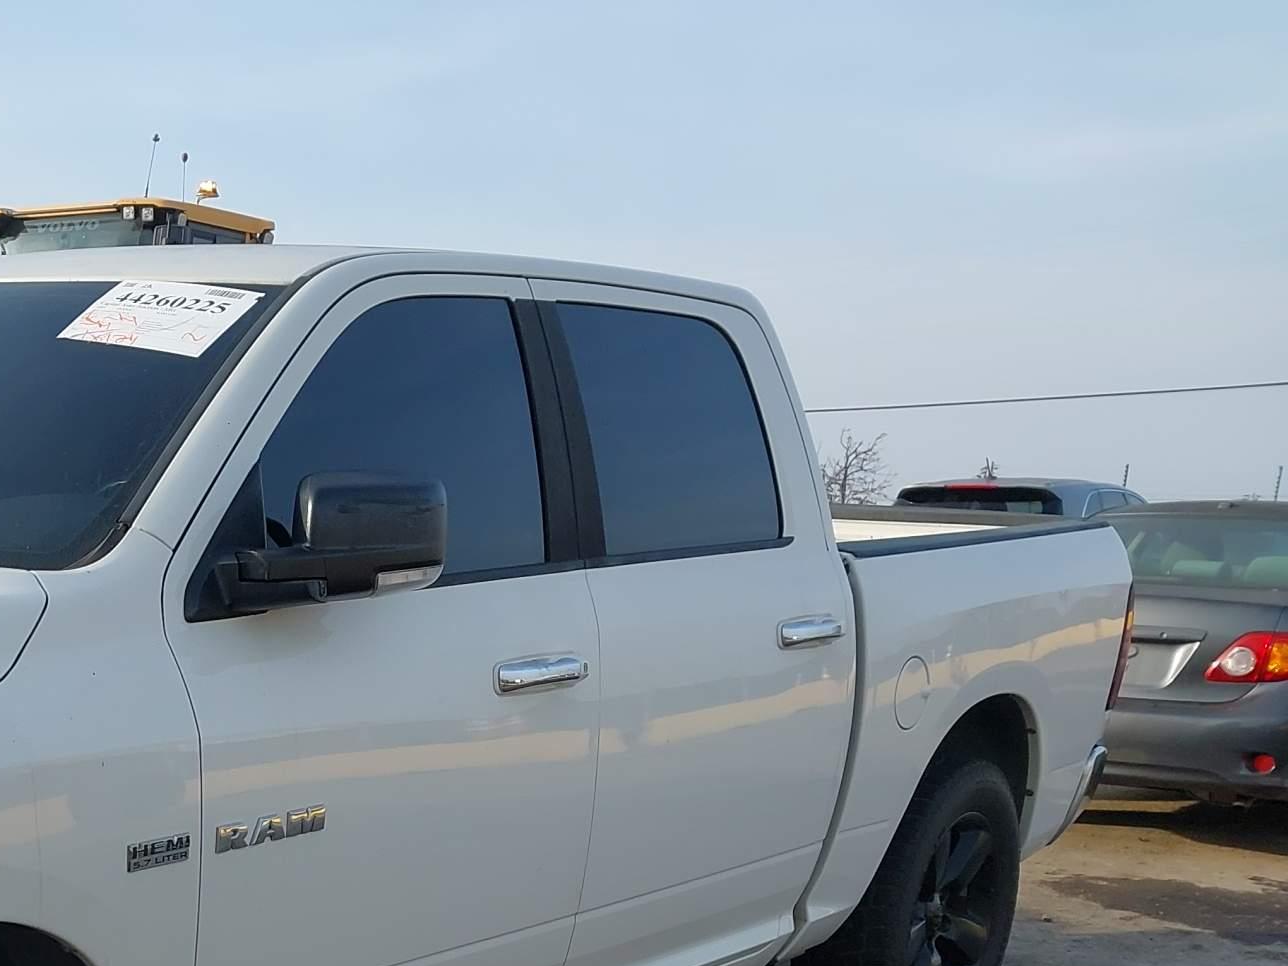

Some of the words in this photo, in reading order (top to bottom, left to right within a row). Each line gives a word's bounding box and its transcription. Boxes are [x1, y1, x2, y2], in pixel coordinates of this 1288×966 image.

[37, 219, 99, 233] VOLVO
[115, 291, 232, 314] 44260225
[215, 803, 327, 854] RAM
[131, 834, 191, 860] HEMI
[133, 858, 152, 870] 5.7
[154, 850, 188, 864] LITER
